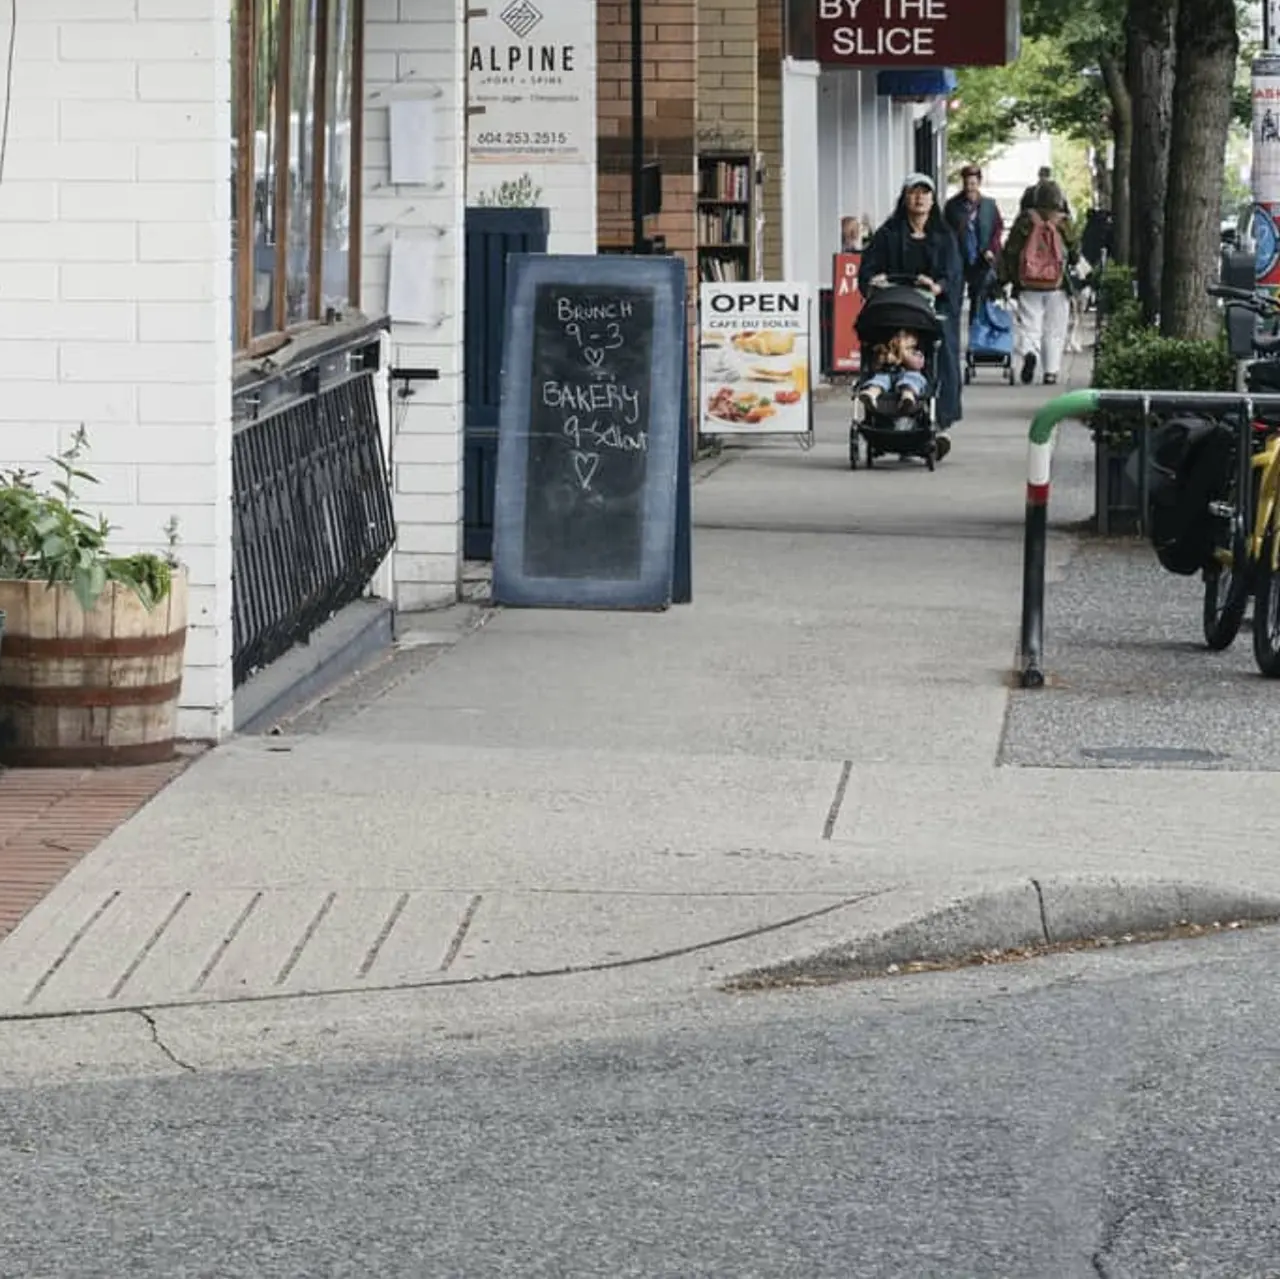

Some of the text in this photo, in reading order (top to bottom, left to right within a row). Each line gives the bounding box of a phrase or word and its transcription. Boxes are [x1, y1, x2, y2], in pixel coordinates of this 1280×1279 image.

[832, 26, 936, 55] SLICE
[470, 45, 575, 71] ALPINE
[477, 131, 567, 145] 604.253.2515
[557, 297, 633, 321] BRUNCH
[710, 293, 800, 313] OPEN
[742, 321, 759, 329] DU
[543, 380, 639, 424] BAKERY
